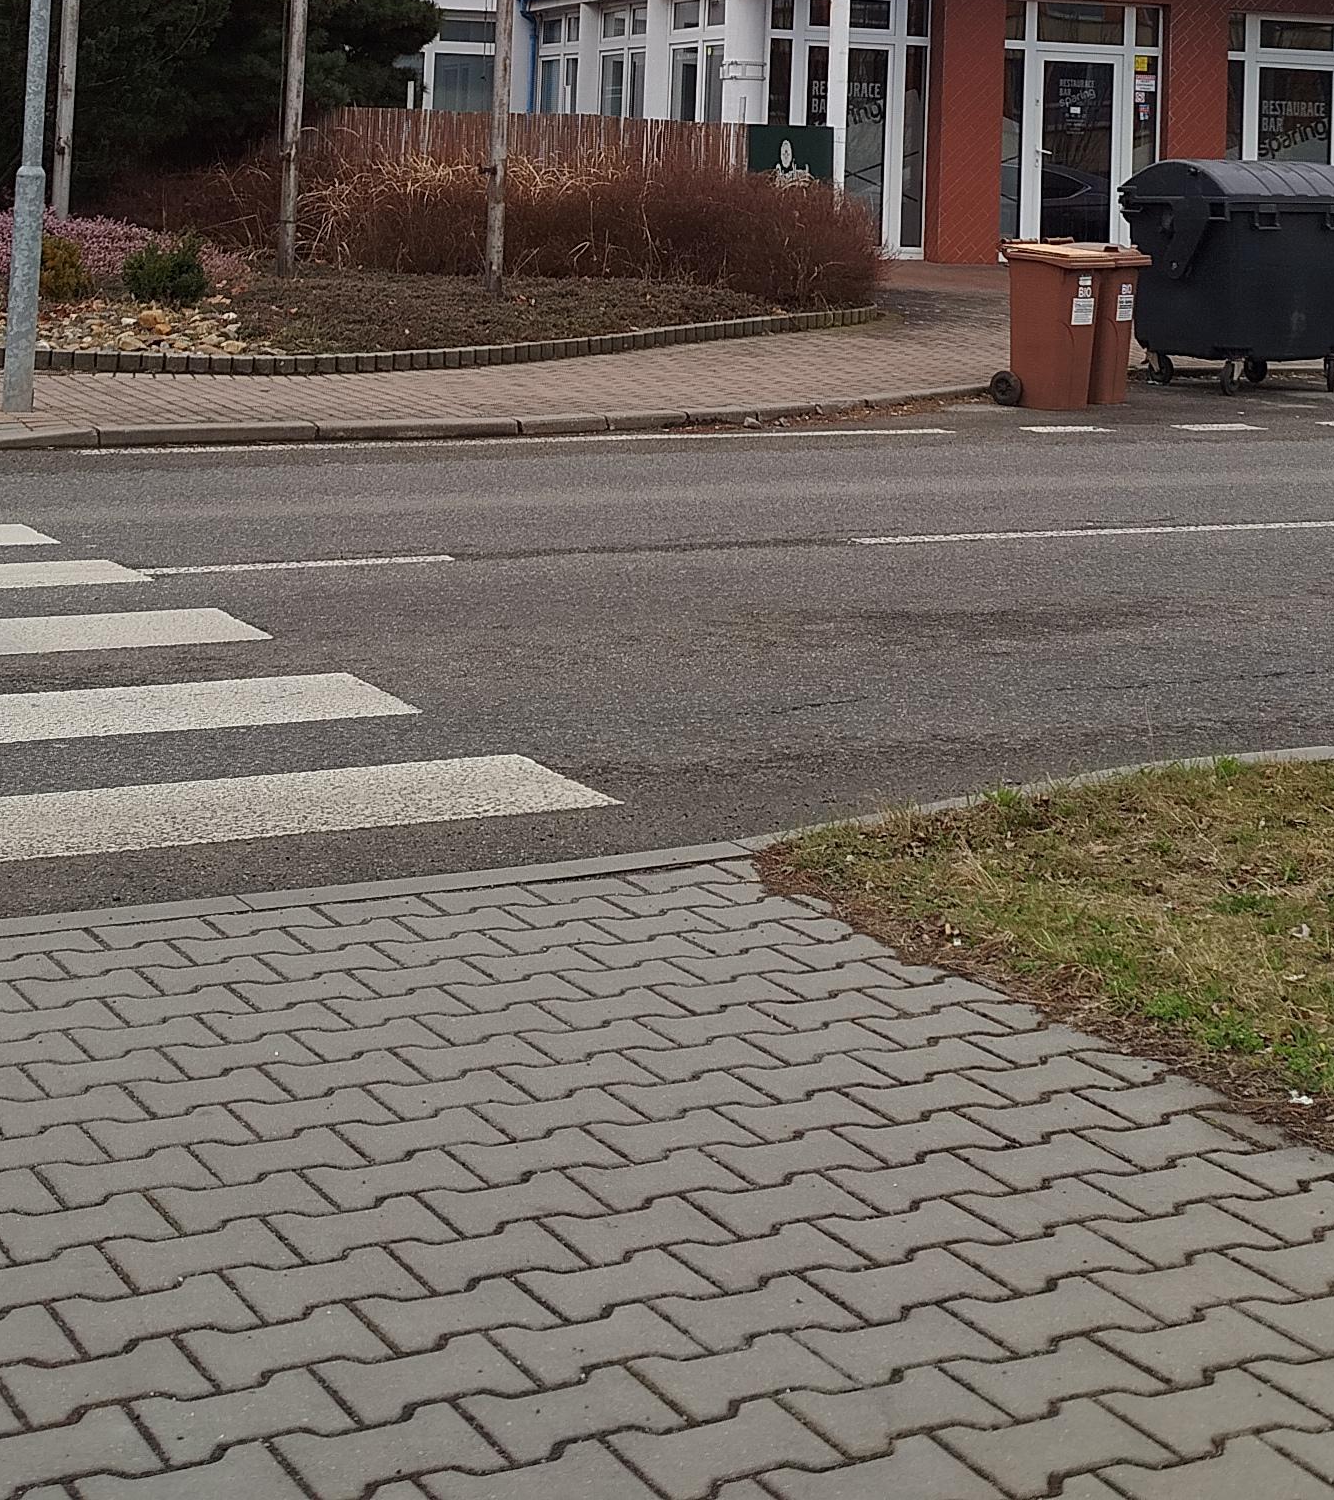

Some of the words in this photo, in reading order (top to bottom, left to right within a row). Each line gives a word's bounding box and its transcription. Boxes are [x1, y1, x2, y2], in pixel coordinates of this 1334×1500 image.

[811, 98, 827, 113] BA
[1261, 100, 1326, 117] RESTAURACE
[1261, 117, 1284, 132] BAR
[1258, 117, 1329, 159] sparing
[1078, 287, 1092, 297] BIO
